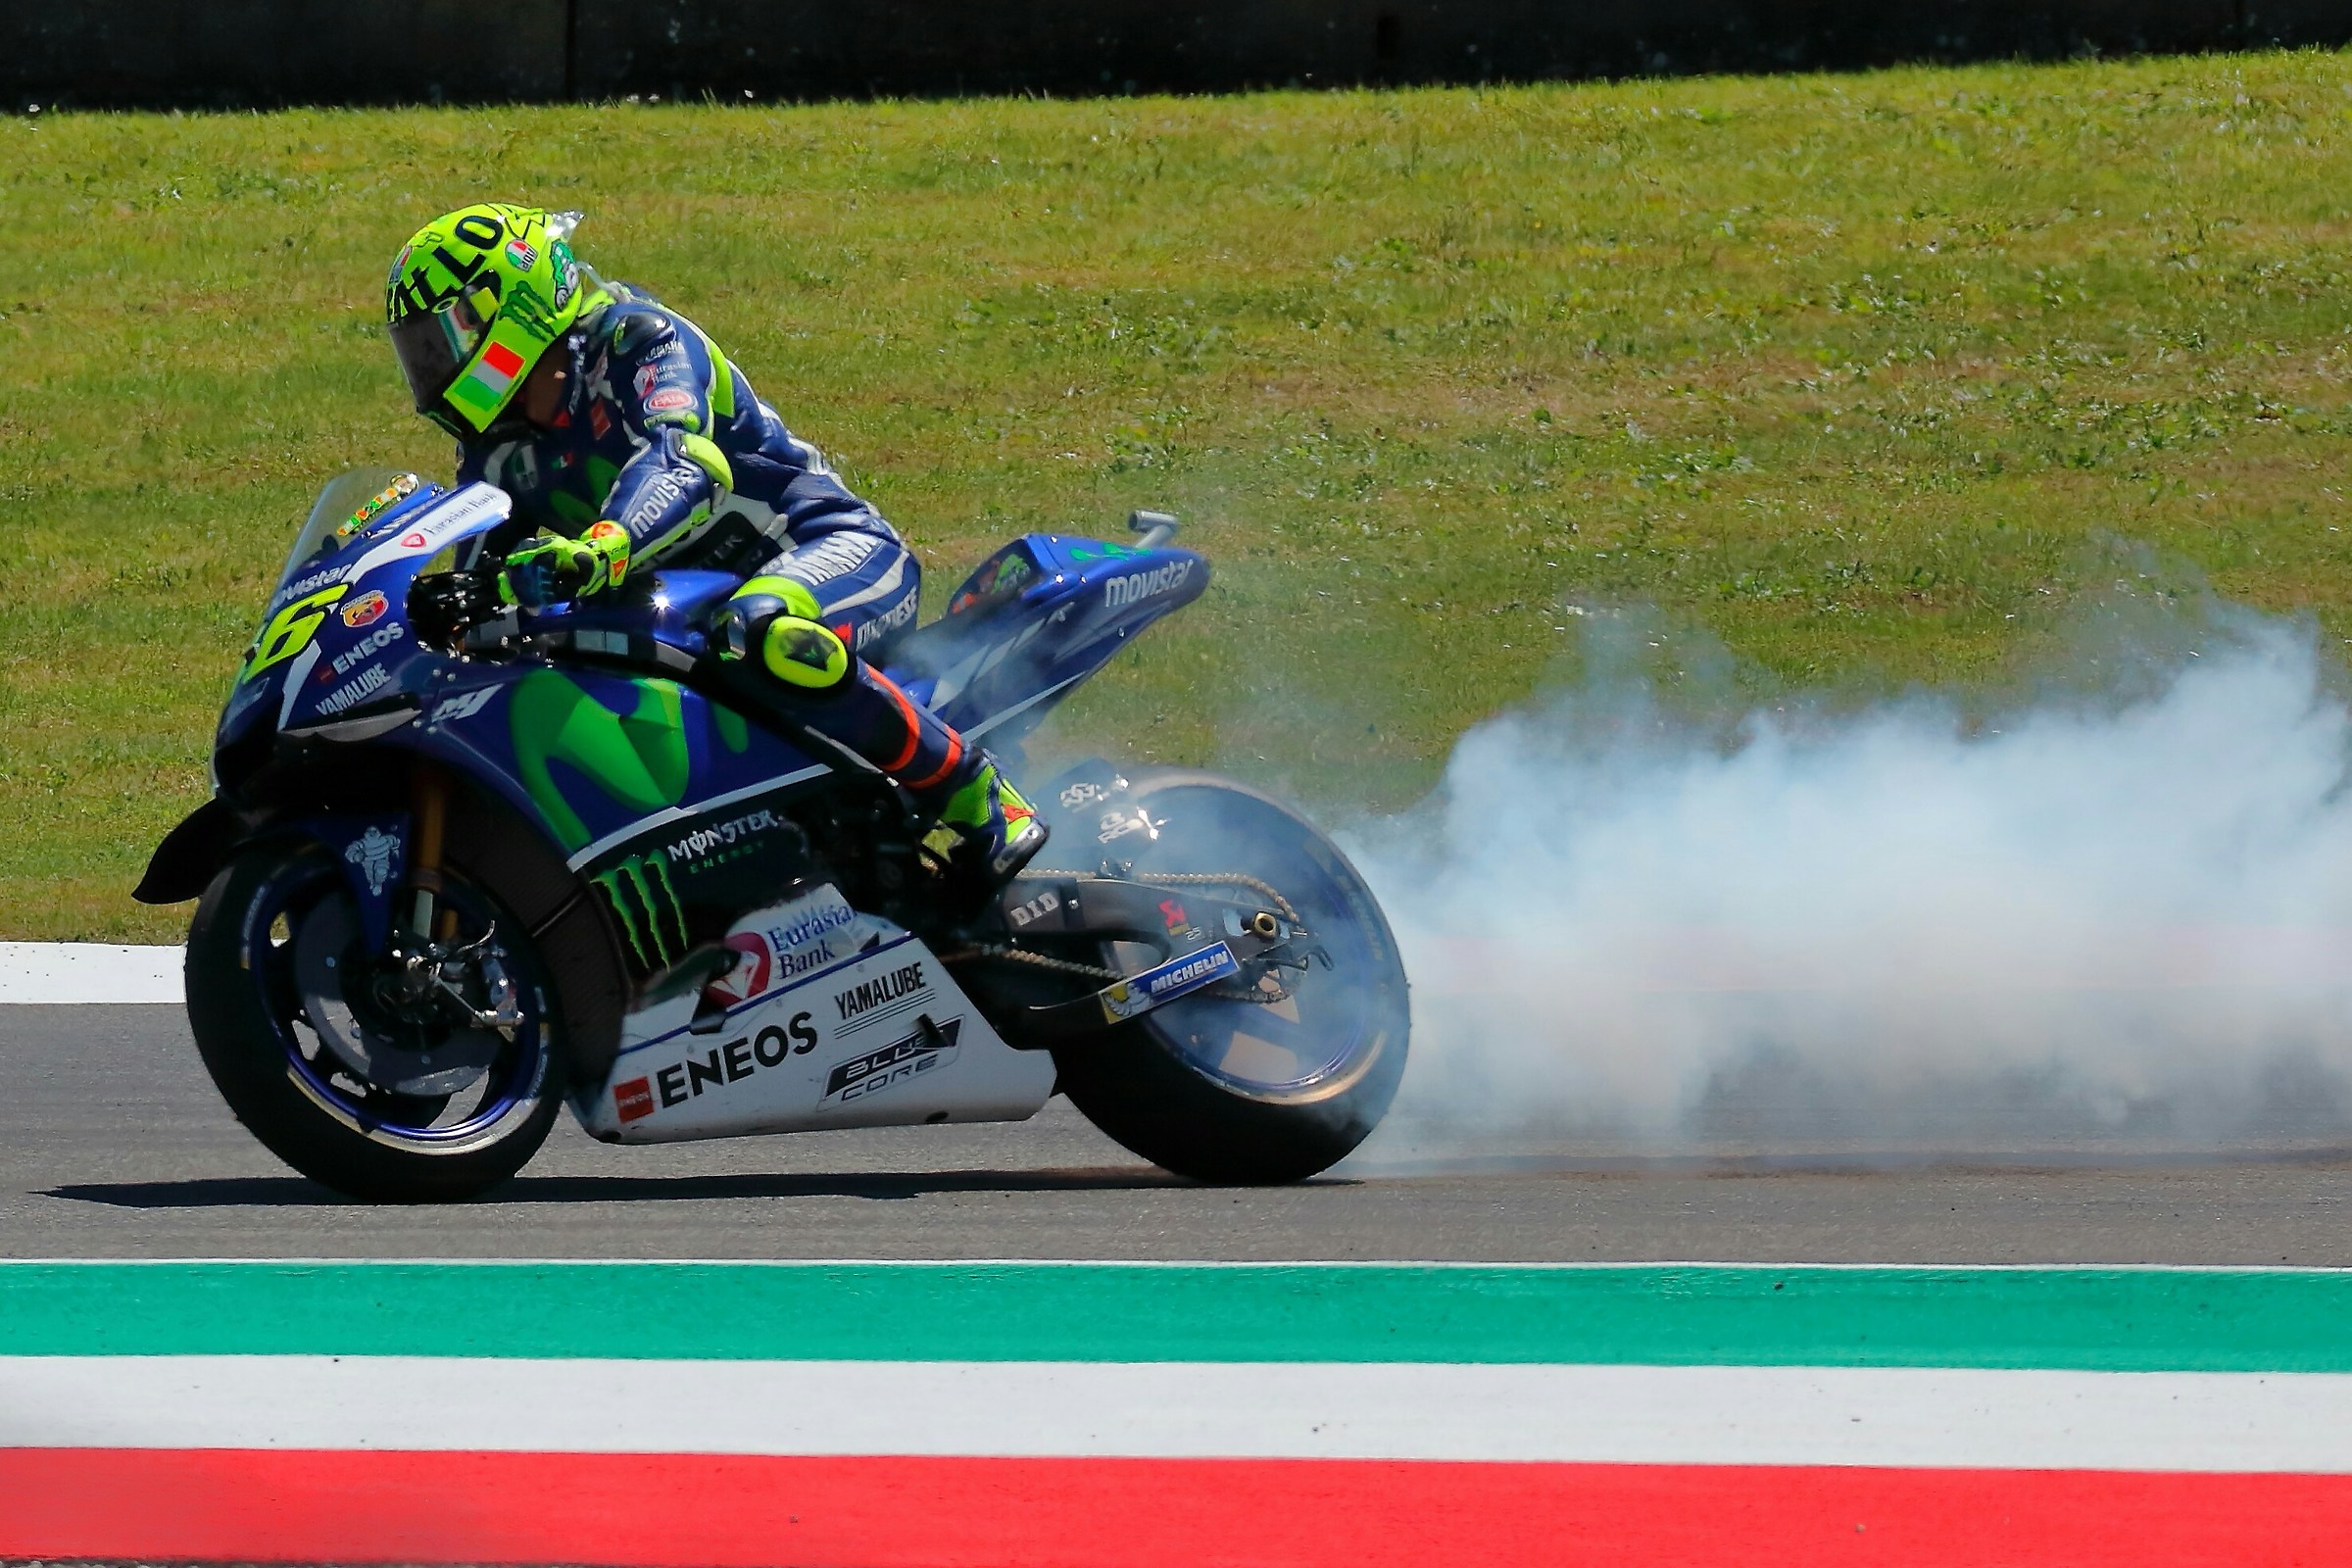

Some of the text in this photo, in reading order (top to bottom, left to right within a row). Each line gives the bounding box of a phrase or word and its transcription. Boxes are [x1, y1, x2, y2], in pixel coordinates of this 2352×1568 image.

[1104, 559, 1194, 608] movistar
[332, 621, 405, 675] ENEOS
[316, 662, 392, 715] YAMALUBE
[667, 809, 778, 861] MONSTER
[1010, 892, 1059, 927] DID
[777, 939, 836, 980] Bank
[1151, 950, 1229, 994] MICHELIN
[835, 961, 927, 1019] YAMALUBE
[656, 1011, 817, 1108] ENEOS
[841, 1054, 939, 1102] CORE
[845, 1035, 928, 1079] BLUE
